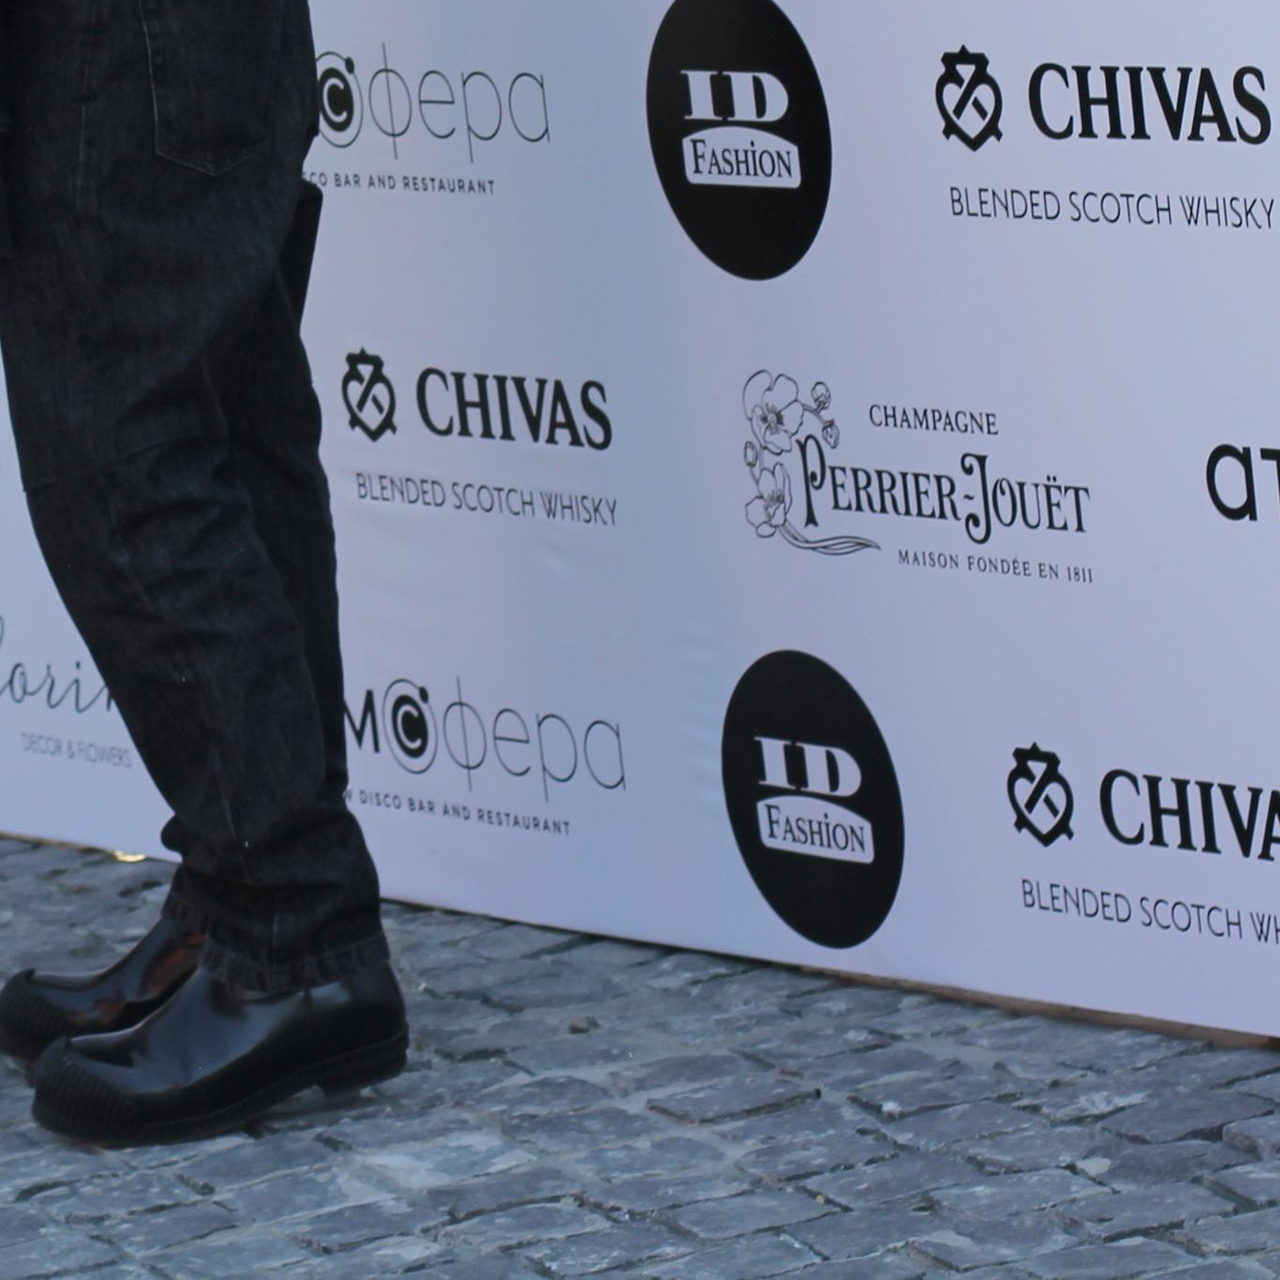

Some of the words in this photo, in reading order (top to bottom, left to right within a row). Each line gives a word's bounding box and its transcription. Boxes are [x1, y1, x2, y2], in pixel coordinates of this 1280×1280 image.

[681, 70, 789, 122] ID
[1028, 62, 1272, 145] CHIVAS
[334, 173, 360, 187] BAR
[368, 174, 396, 190] AND
[403, 176, 495, 195] RESTAURANT
[950, 186, 1060, 220] BLENDED
[1069, 191, 1172, 225] SCOTCH
[1180, 195, 1274, 230] WHISKY
[416, 367, 613, 451] CHIVAS
[869, 404, 999, 436] CHAMPAGNE
[356, 472, 446, 508] BLENDED
[452, 482, 535, 518] SCOTCH
[540, 491, 617, 526] WHISKY
[898, 549, 959, 570] MAISON
[967, 554, 1032, 578] FONDÉE
[1039, 562, 1059, 580] EN
[1067, 566, 1094, 584] 1811
[754, 736, 862, 797] ID
[360, 790, 402, 810] DISCO
[408, 797, 435, 815] BAR
[442, 803, 470, 821] AND
[477, 809, 570, 836] RESTAURANT
[1022, 879, 1132, 923] BLENDED
[1140, 896, 1243, 940] SCOTCH
